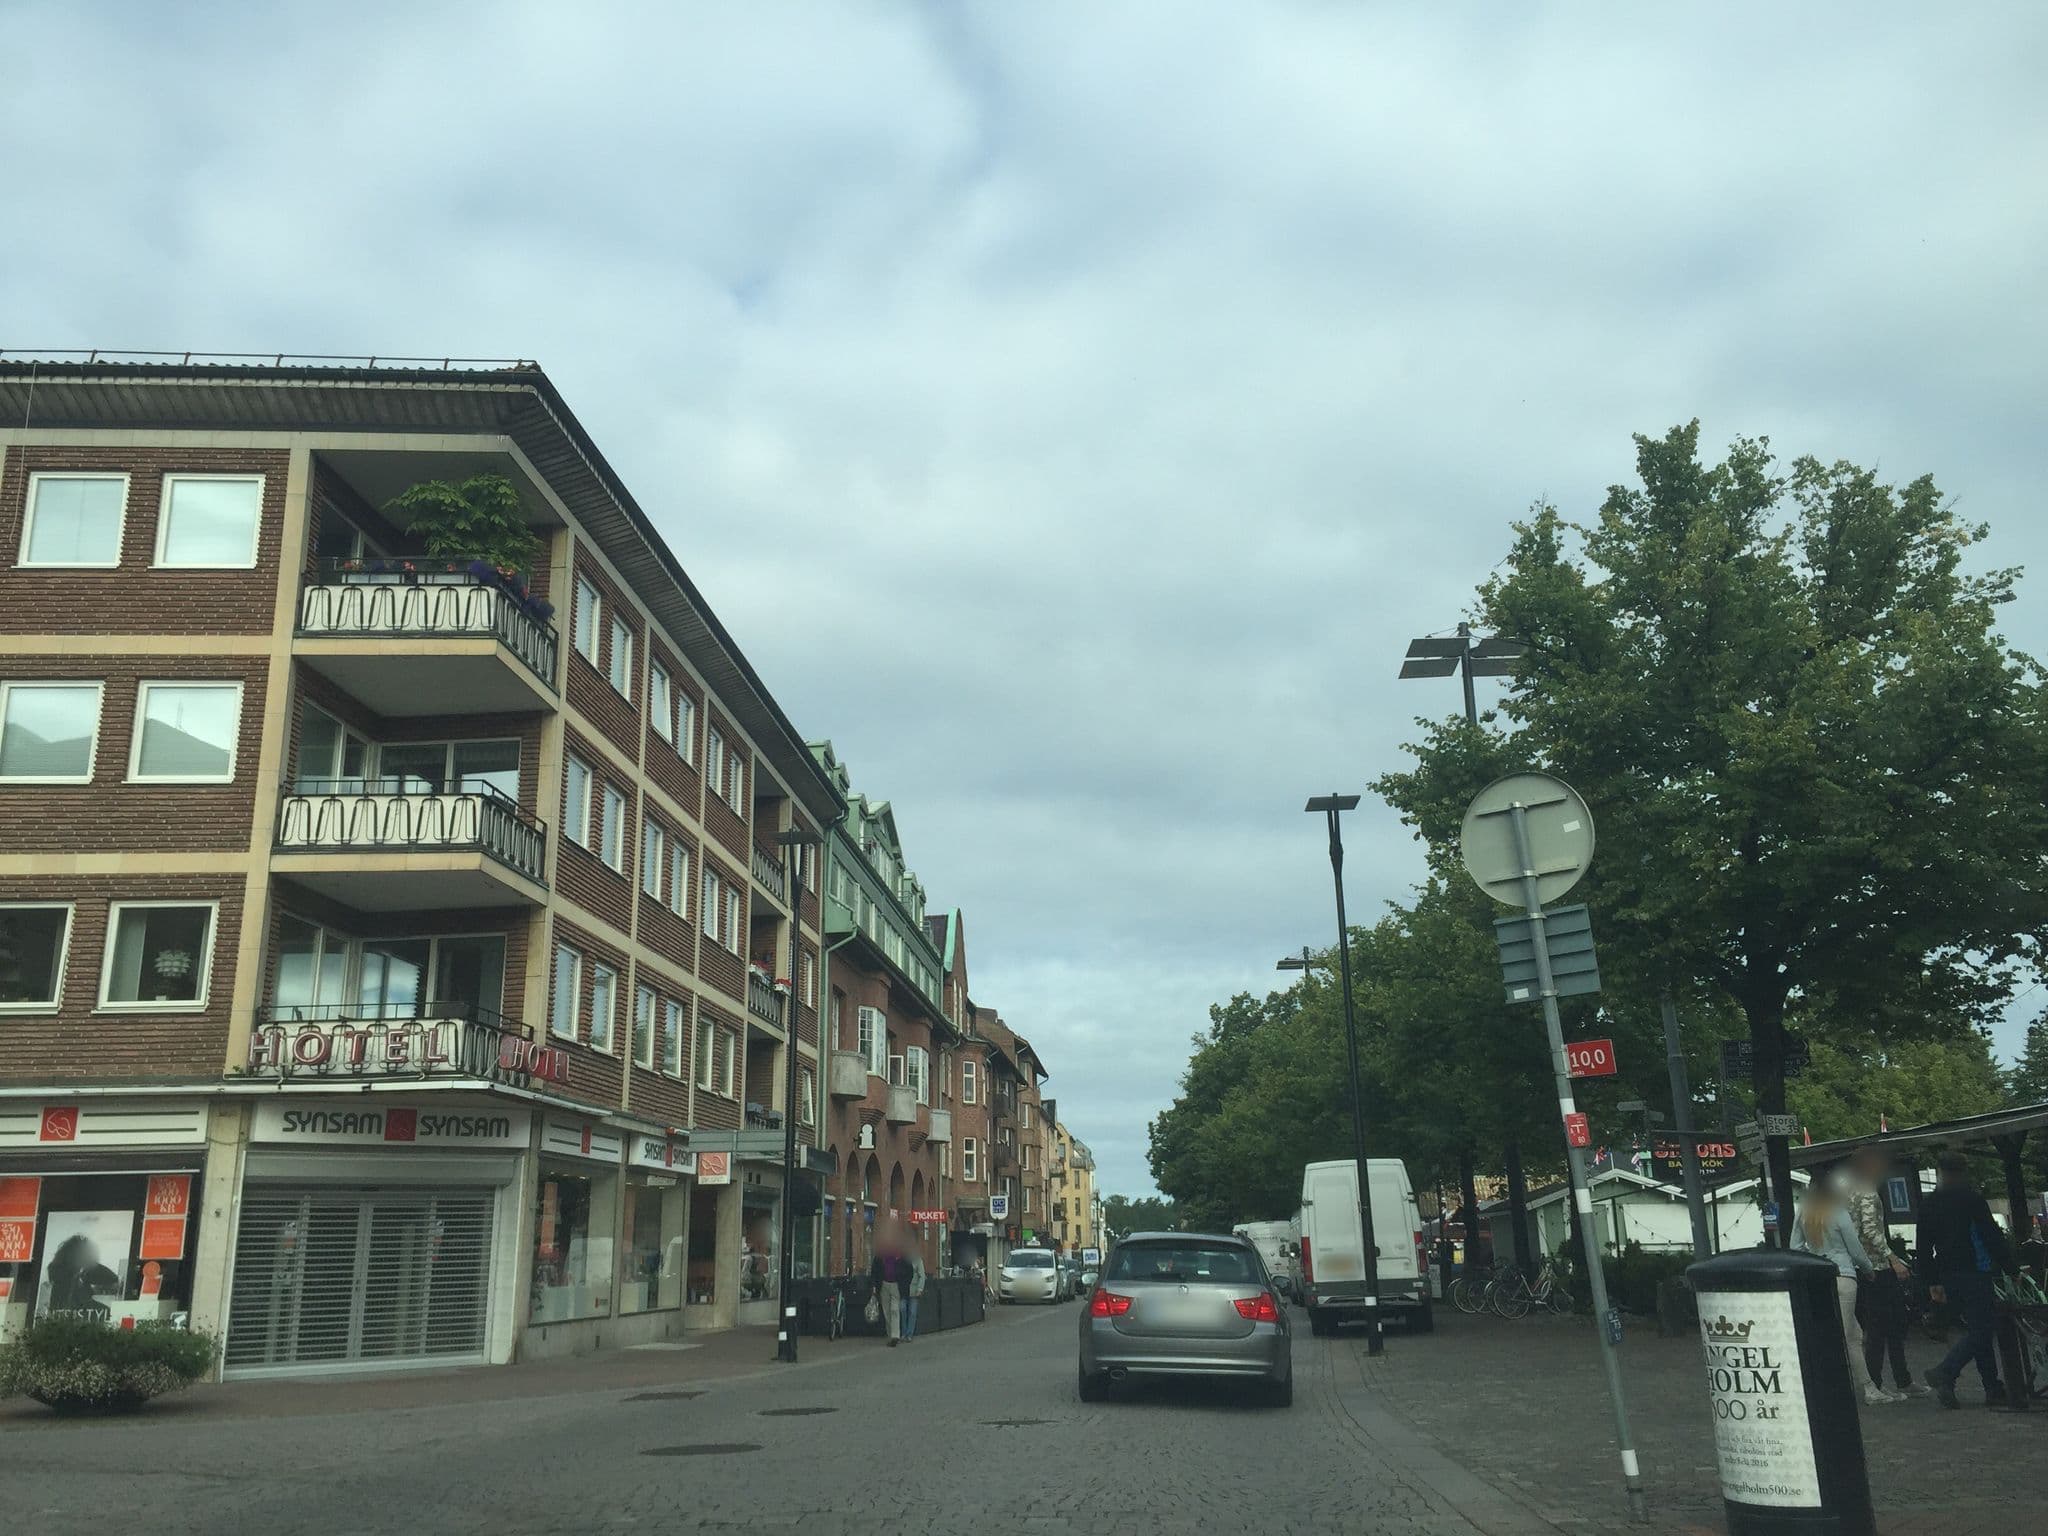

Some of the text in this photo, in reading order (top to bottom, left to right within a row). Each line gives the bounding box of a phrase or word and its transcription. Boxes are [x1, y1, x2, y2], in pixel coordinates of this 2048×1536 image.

[250, 1028, 449, 1068] HOTEL
[503, 1036, 572, 1082] HOTEL
[1570, 1049, 1606, 1069] 10,0
[282, 1110, 510, 1139] SYNSAM SYNSAM
[1705, 1345, 1781, 1369] NGEL
[1756, 1399, 1780, 1420] år
